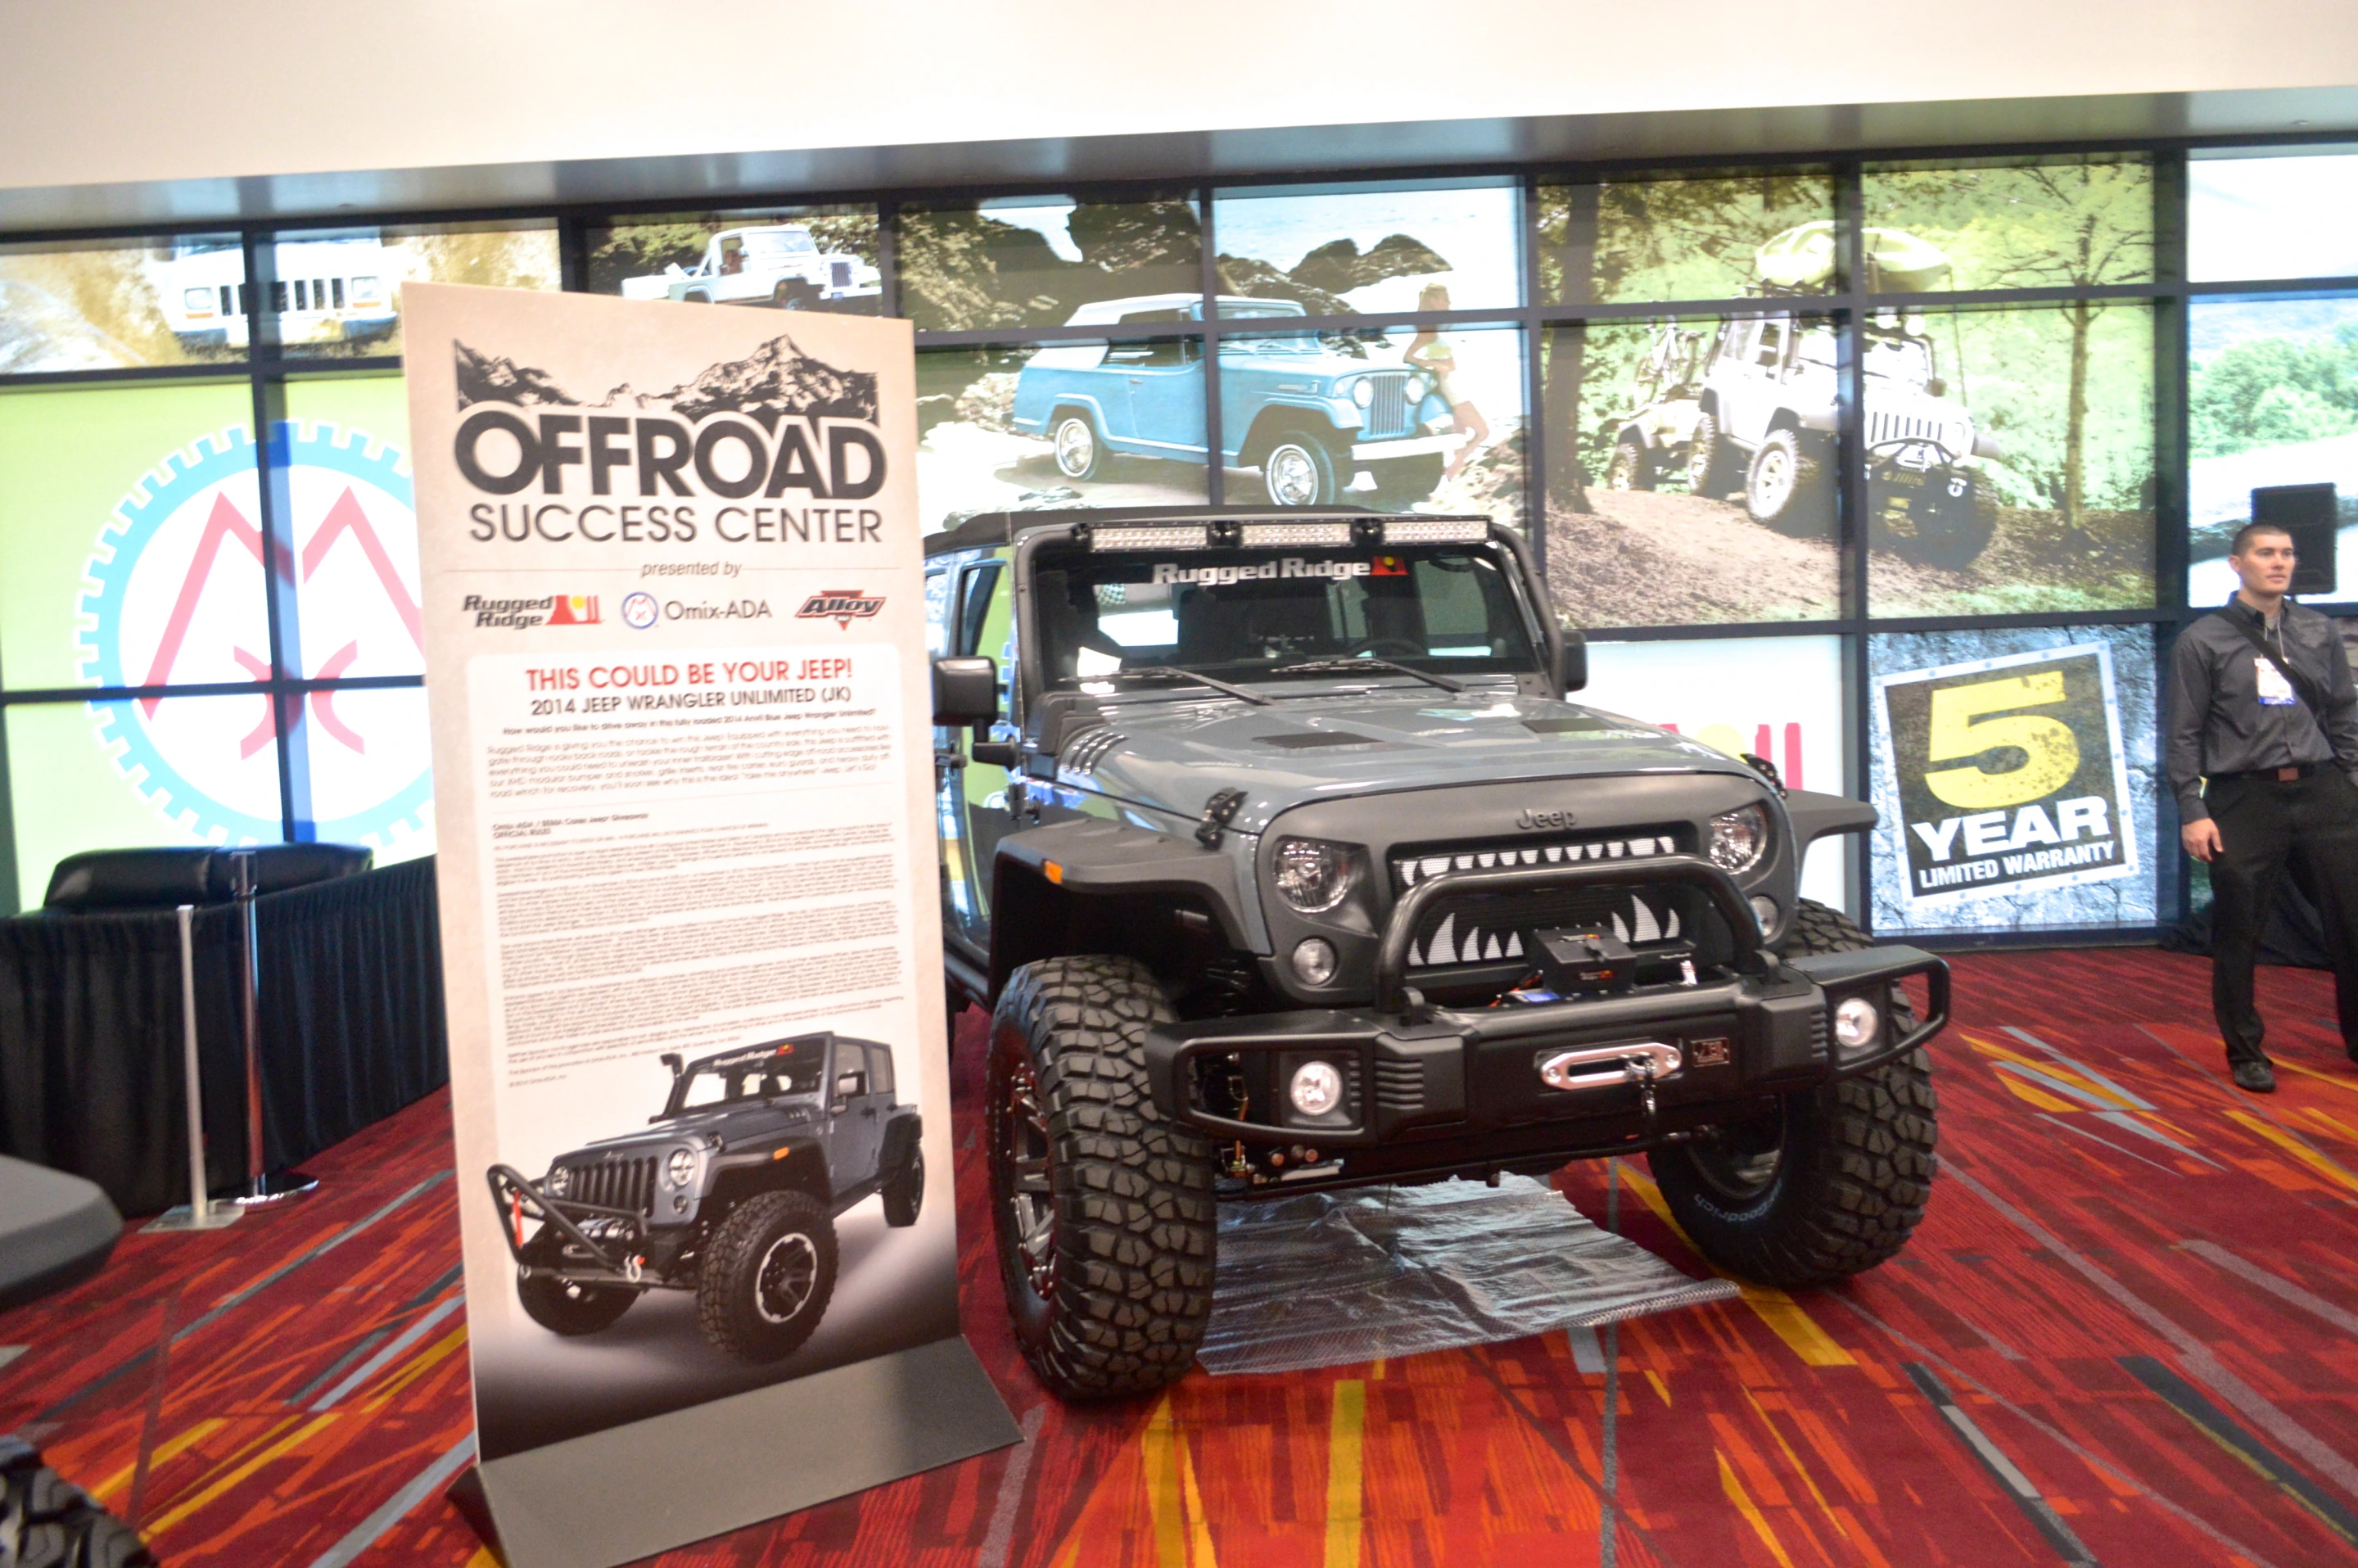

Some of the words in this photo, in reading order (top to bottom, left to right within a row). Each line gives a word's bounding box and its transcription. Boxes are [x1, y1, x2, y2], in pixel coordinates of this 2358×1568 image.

[455, 410, 887, 499] OFFROAD
[470, 504, 698, 542] SUCCESS
[715, 506, 883, 543] CENTER
[640, 561, 720, 578] presented
[724, 561, 742, 577] by
[1152, 561, 1277, 586] Rugged
[1279, 558, 1371, 581] Ridge
[462, 594, 554, 612] Rugged
[664, 600, 772, 620] Omix-ADA
[801, 598, 881, 614] Alloy
[475, 612, 544, 630] Ridge
[526, 667, 580, 691] THIS
[588, 664, 680, 689] COULD
[688, 663, 715, 685] BE
[722, 661, 789, 683] YOUR
[797, 658, 852, 680] JEEP!
[531, 698, 576, 716] 2014
[582, 696, 621, 714] JEEP
[627, 691, 725, 711] WRANGLER
[730, 688, 815, 707] UNLIMITED
[821, 686, 852, 704] (JK)
[1925, 671, 2080, 808] 5
[1516, 809, 1577, 830] Jeep
[1911, 796, 2111, 861] YEAR
[1919, 859, 1999, 888] LIMITED
[2002, 841, 2114, 875] WARRANTY
